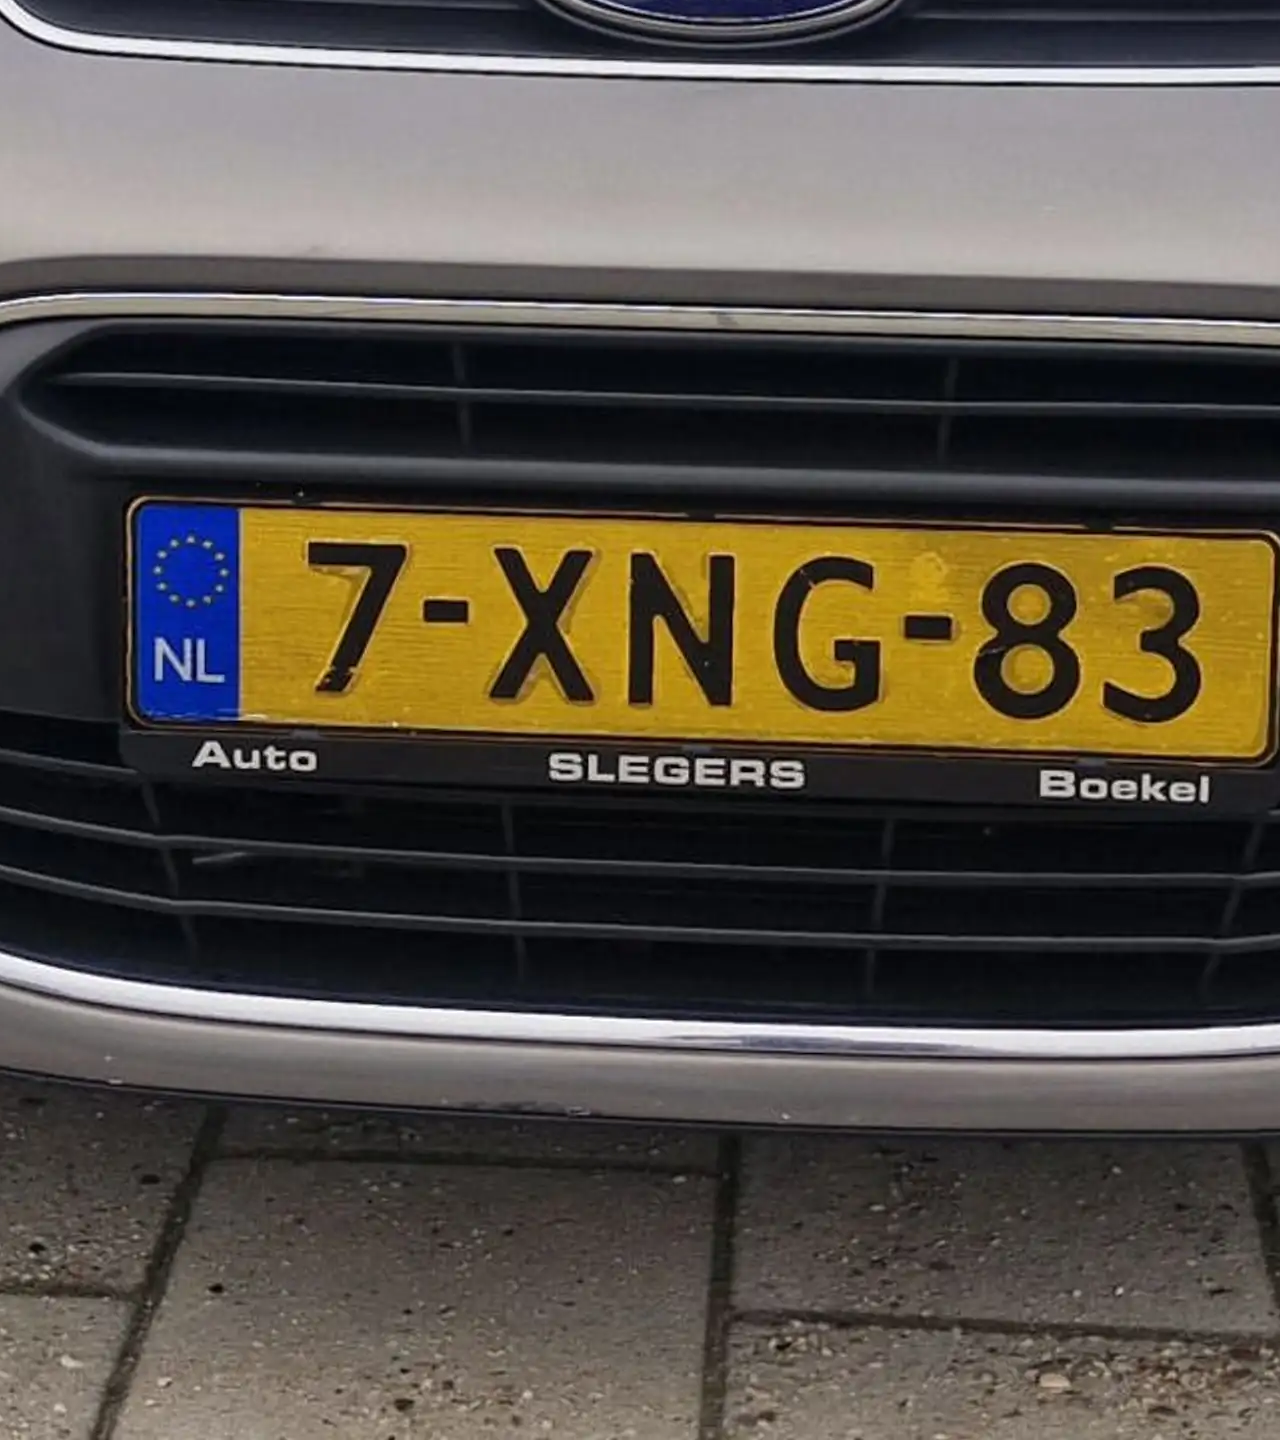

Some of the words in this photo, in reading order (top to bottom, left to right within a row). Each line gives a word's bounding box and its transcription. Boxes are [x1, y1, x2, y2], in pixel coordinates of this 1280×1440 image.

[153, 637, 226, 684] NL
[308, 540, 1204, 724] 7-XNG-83
[191, 740, 318, 772] Auto
[548, 752, 806, 789] SLEGERS
[1039, 768, 1210, 804] Boekel
